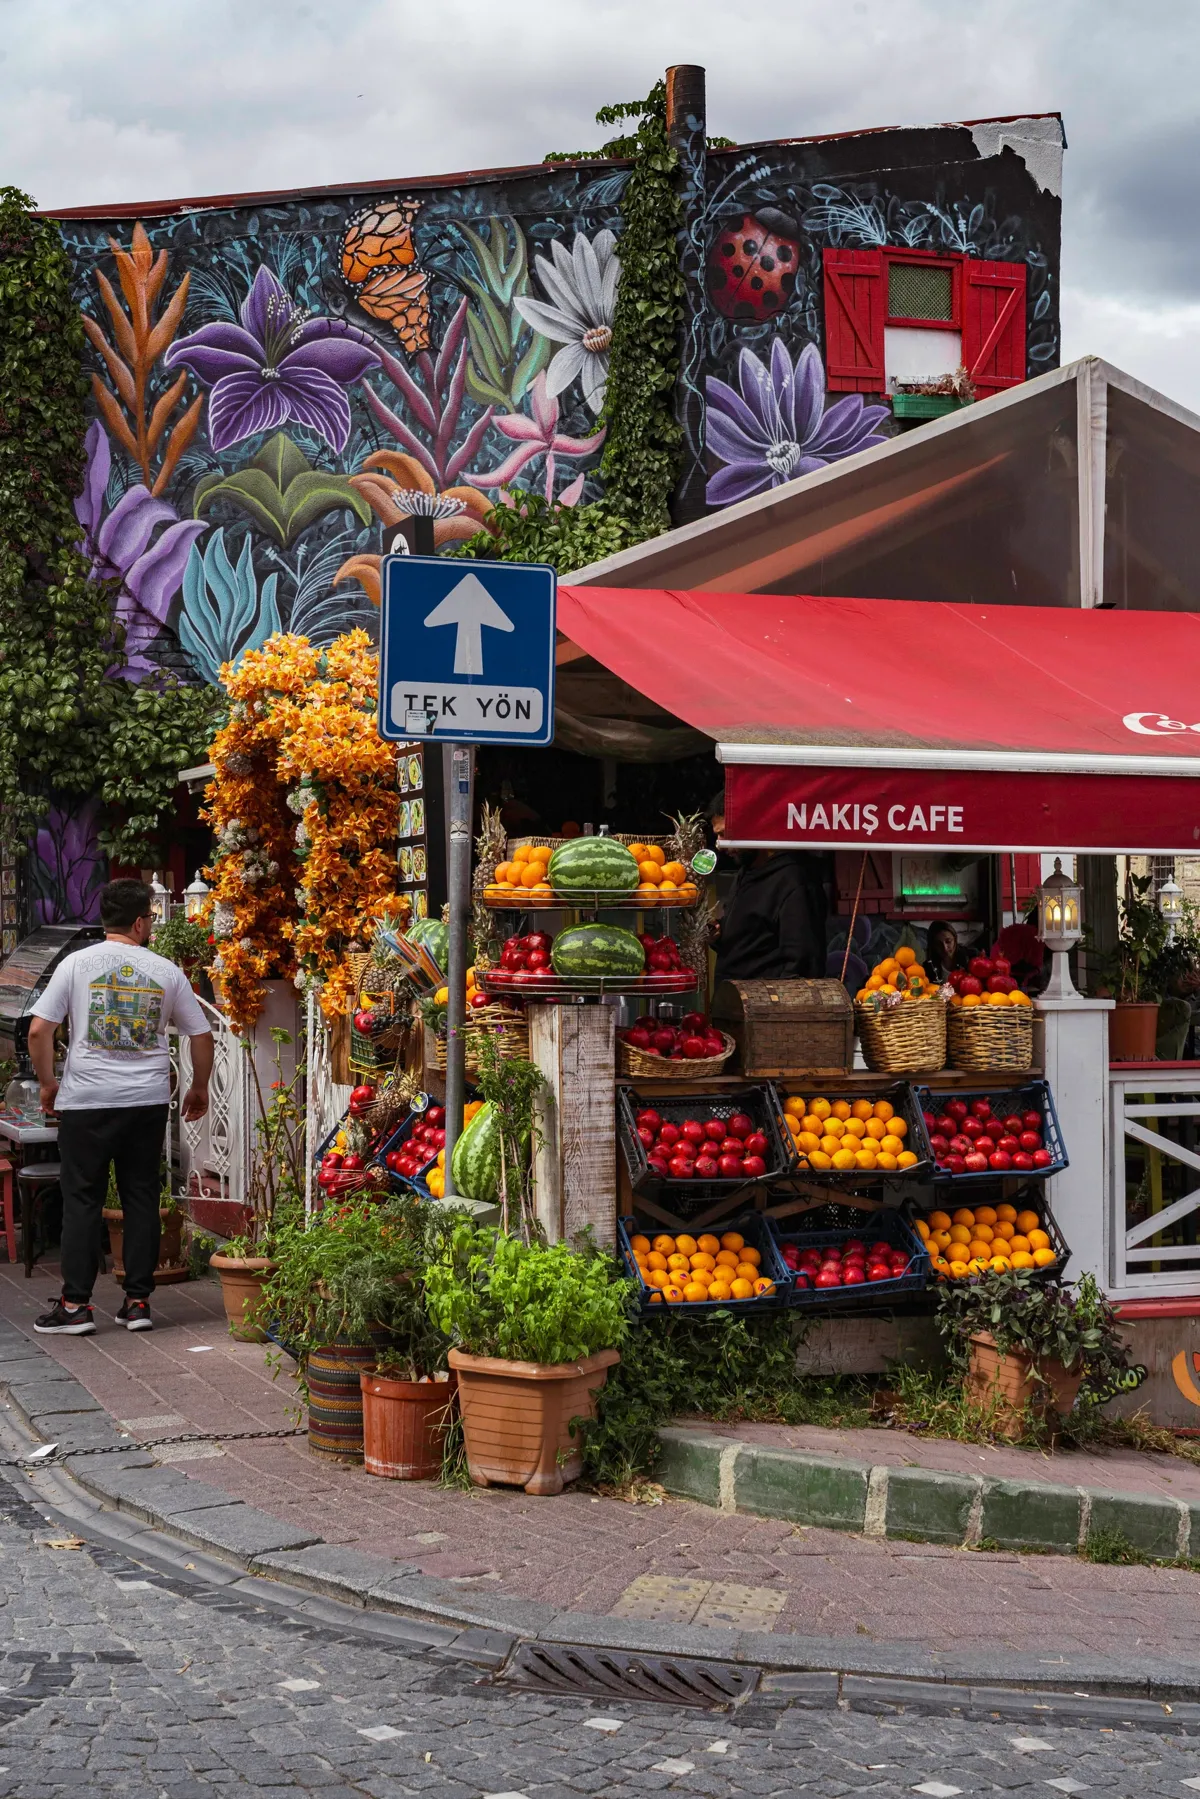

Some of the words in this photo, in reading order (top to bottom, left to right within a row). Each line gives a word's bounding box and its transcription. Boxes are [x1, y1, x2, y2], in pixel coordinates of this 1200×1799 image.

[404, 694, 457, 717] TEK
[476, 693, 531, 720] YÖN
[787, 802, 880, 836] NAKIŞ
[887, 804, 964, 833] CAFE
[78, 954, 122, 974] HOW
